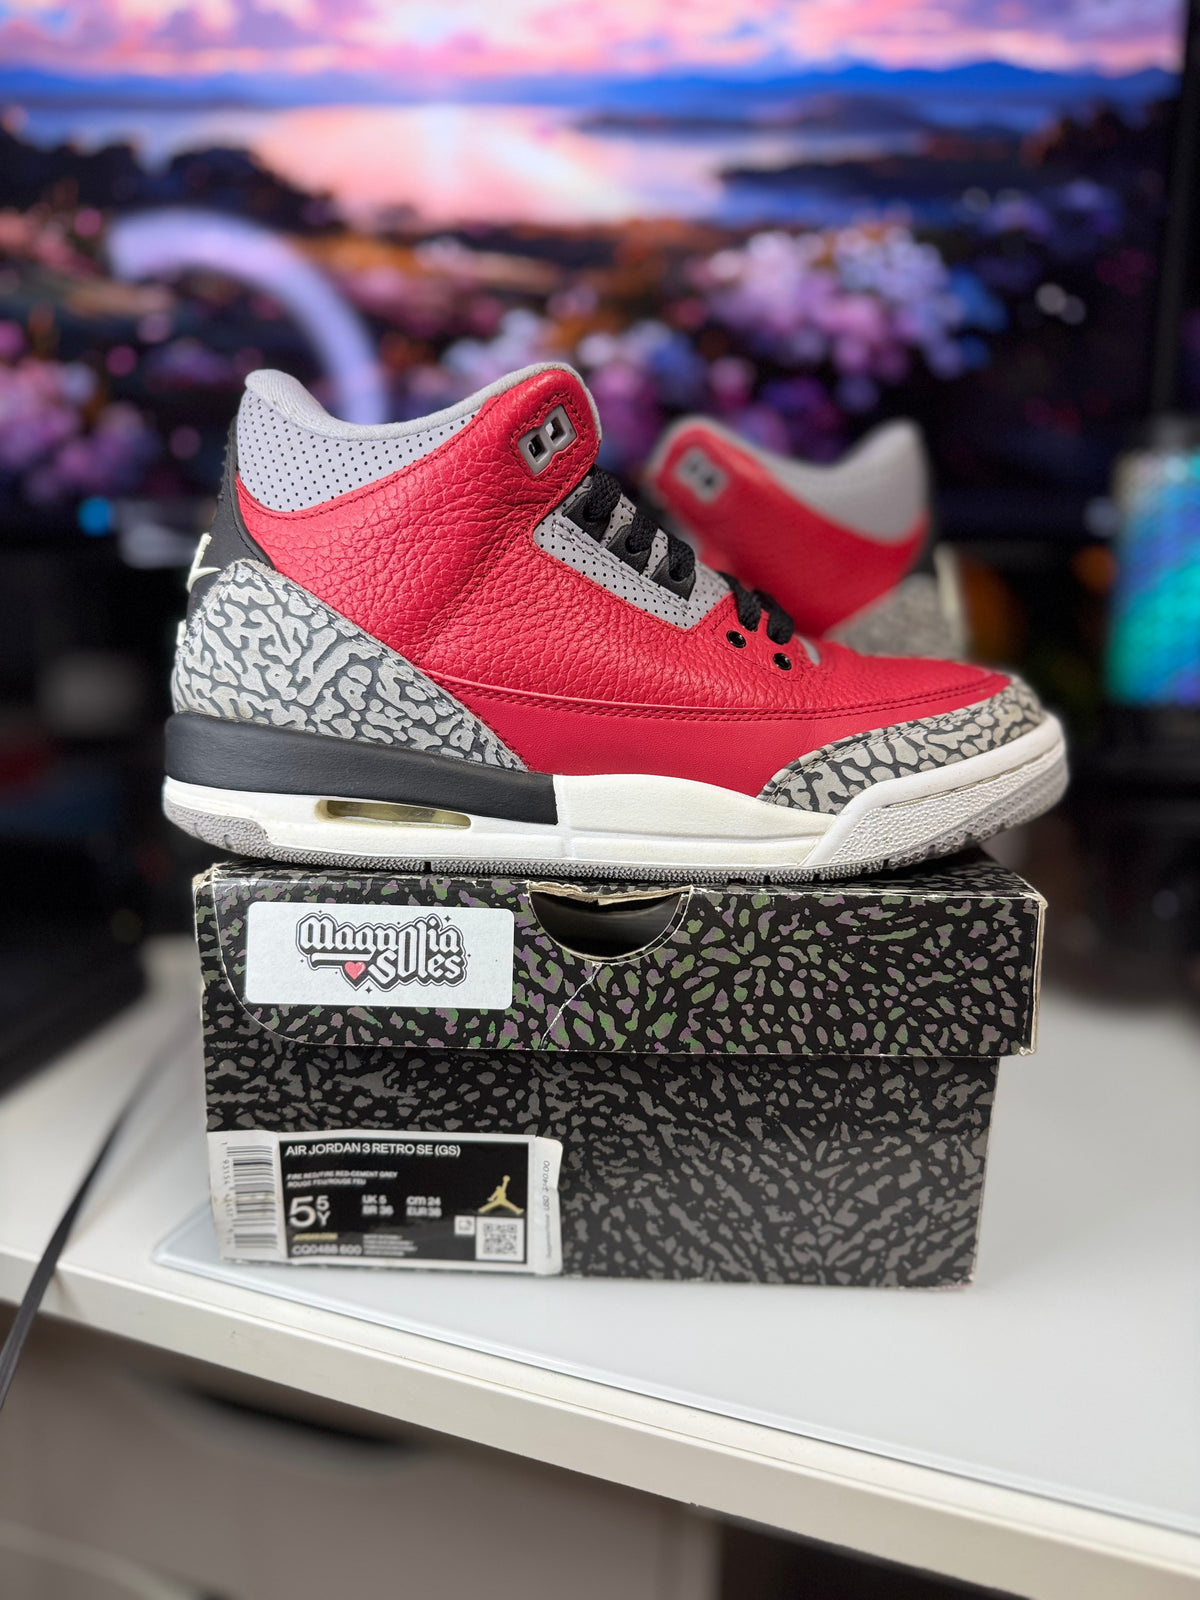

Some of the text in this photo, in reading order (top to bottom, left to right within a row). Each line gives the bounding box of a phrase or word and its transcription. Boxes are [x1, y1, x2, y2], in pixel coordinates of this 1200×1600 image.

[299, 916, 461, 970] Magnolia
[286, 1142, 461, 1157] AIR JORDAN 3 RETRO SE (GS)
[362, 1194, 377, 1204] UK
[427, 1196, 441, 1206] 24
[289, 1195, 330, 1228] 5 5
[316, 1211, 331, 1227] Y
